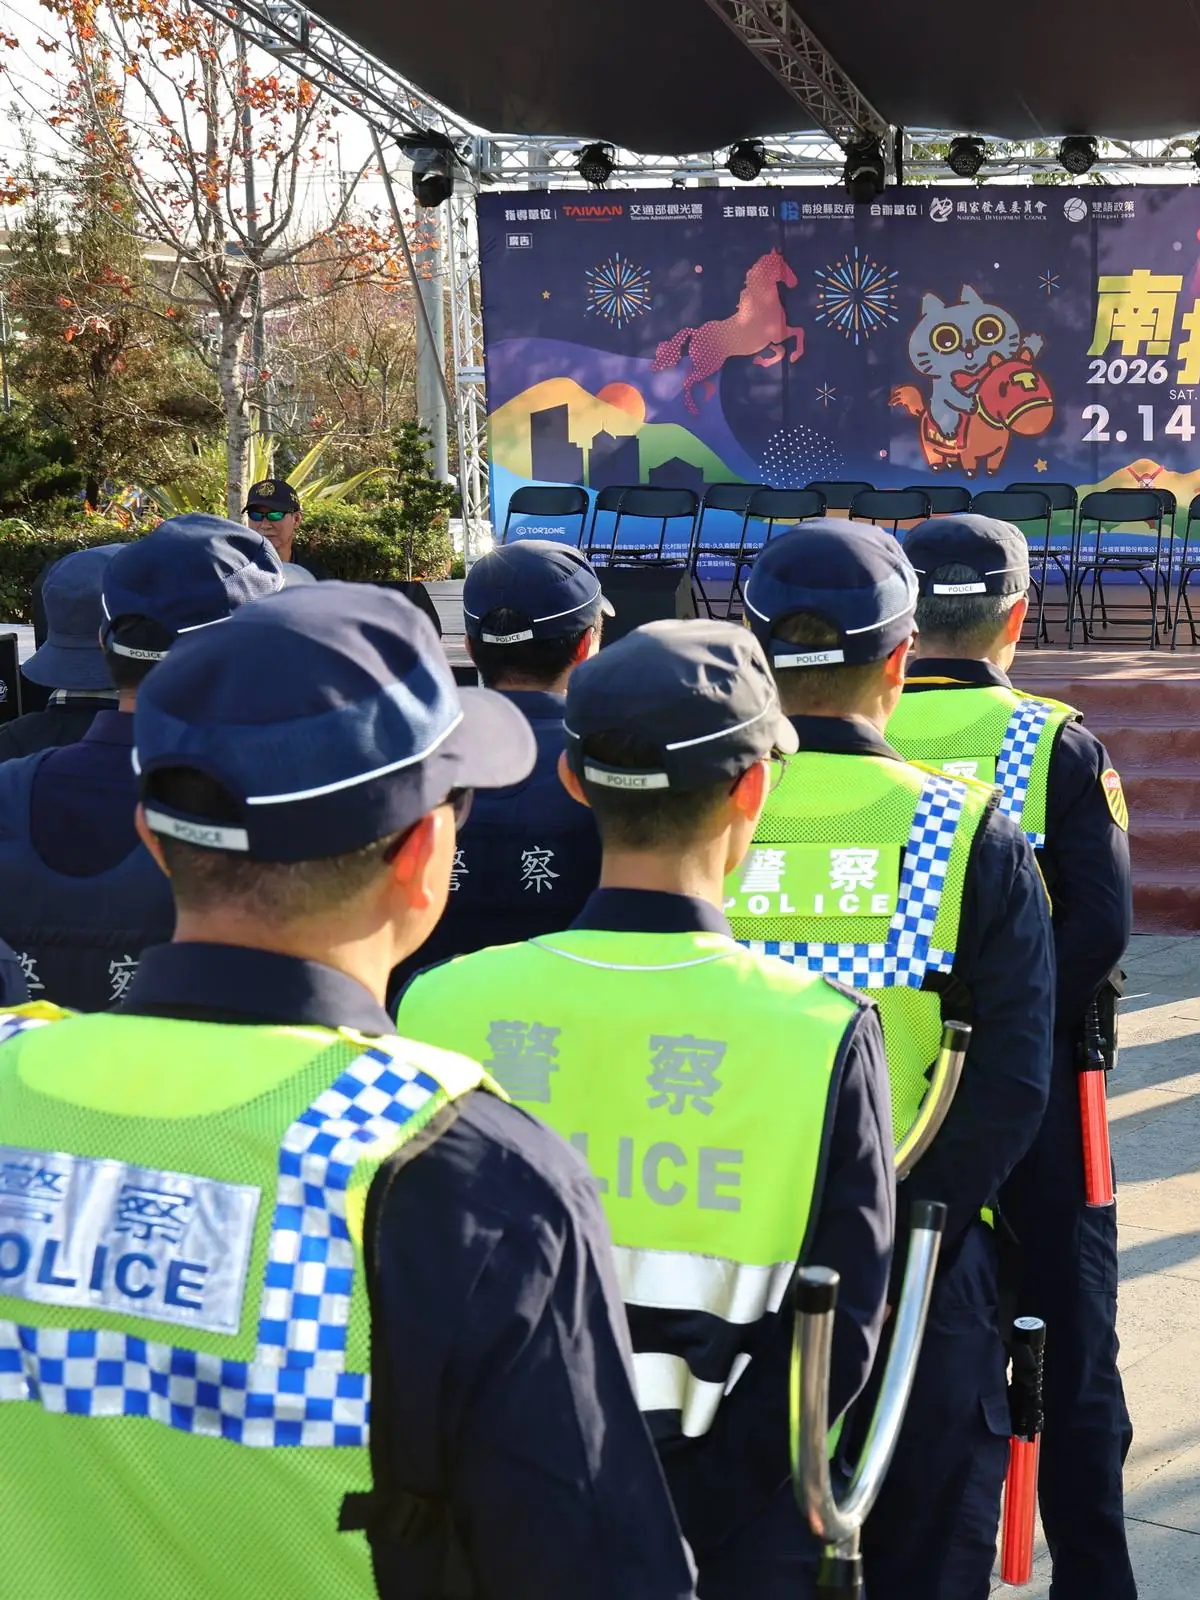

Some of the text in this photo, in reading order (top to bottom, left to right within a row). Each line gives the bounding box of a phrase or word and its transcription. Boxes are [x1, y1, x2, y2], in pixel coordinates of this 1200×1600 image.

[562, 205, 624, 216] TAIWAN
[629, 203, 703, 216] 交通部觀光署
[723, 205, 770, 218] 主辦單位
[802, 204, 855, 214] 南投縣政府
[870, 204, 917, 216] 合辦單位
[957, 200, 1048, 214] 國家發展委員會
[1092, 200, 1135, 213] 雙語政策
[505, 208, 552, 221] 指導單位
[508, 235, 531, 247] 廣告
[1086, 359, 1169, 385] 2026
[1169, 389, 1199, 400] SAT.
[1081, 404, 1196, 442] 2.14
[129, 648, 162, 660] POLICE
[796, 653, 829, 664] POLICE
[606, 774, 647, 787] POLICE
[173, 824, 223, 844] POLICE
[484, 1018, 728, 1117] 警察
[0, 1232, 208, 1311] OLICE
